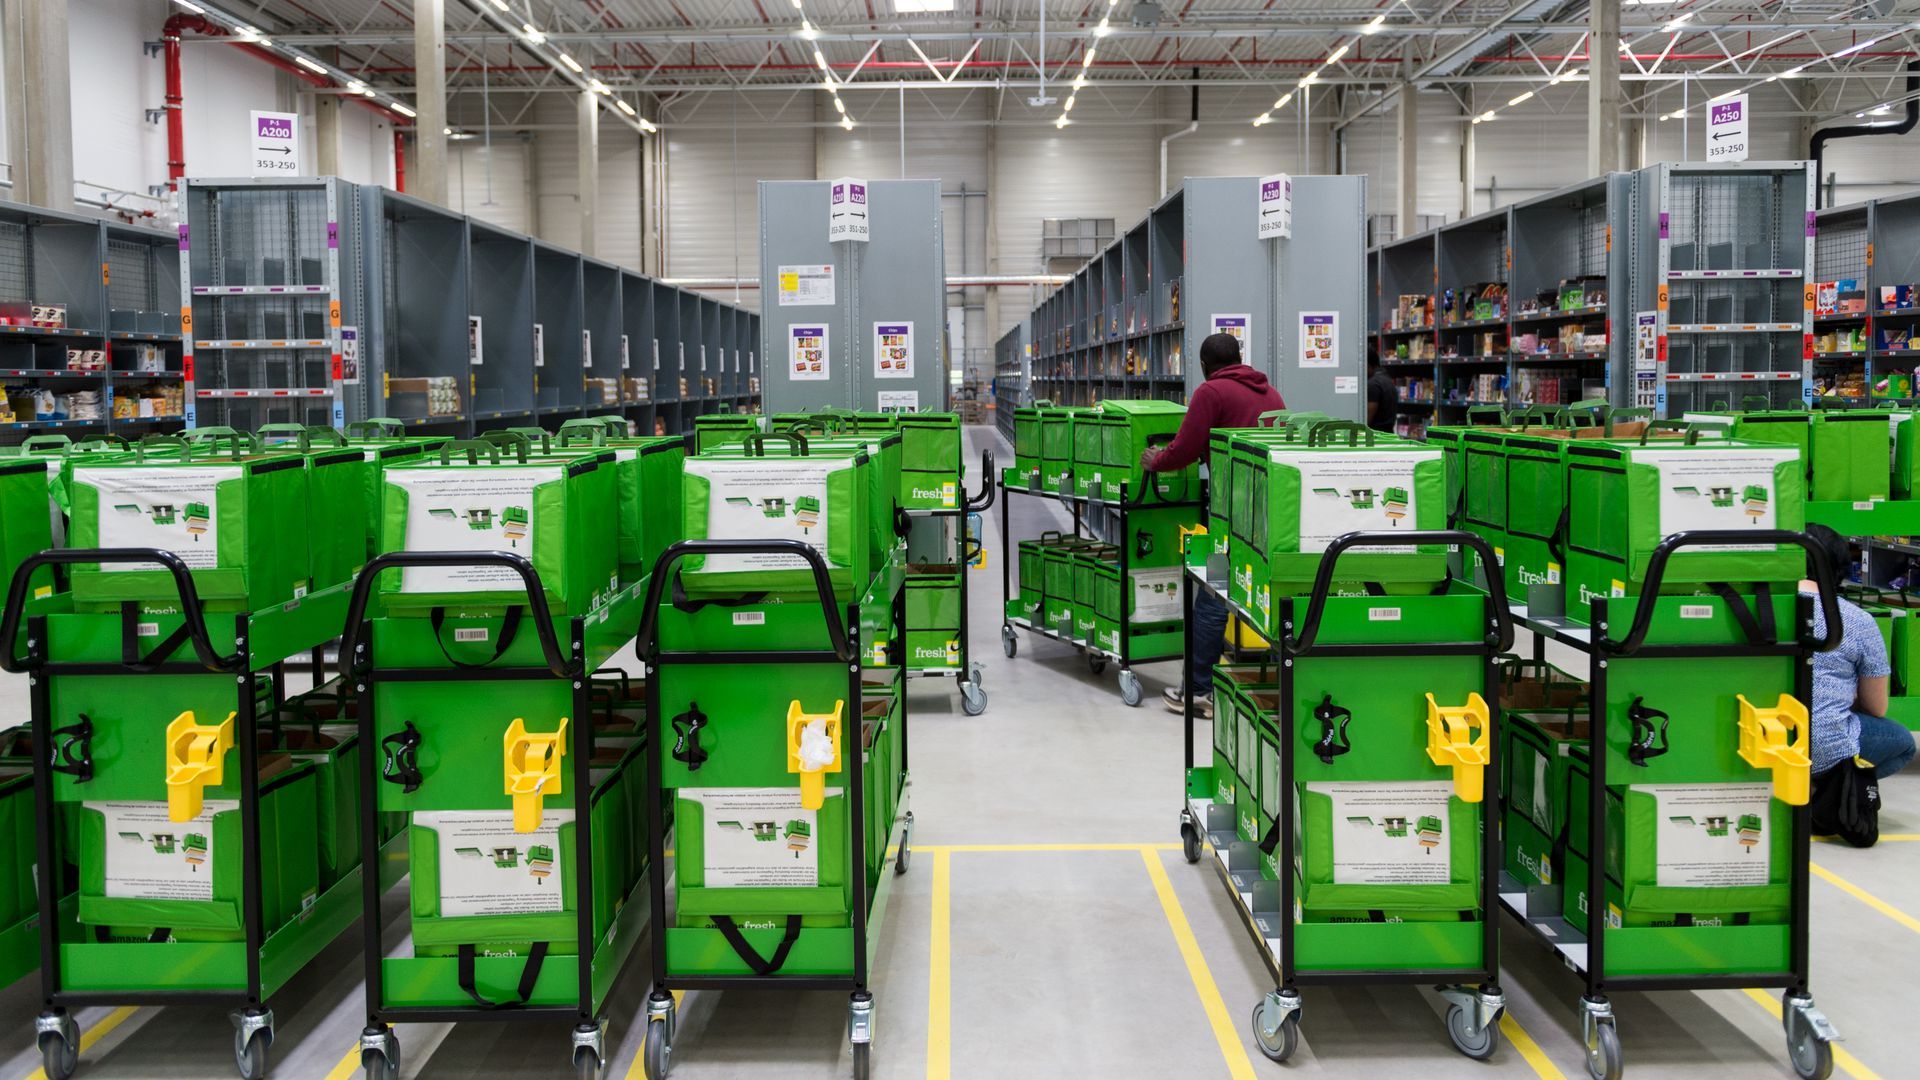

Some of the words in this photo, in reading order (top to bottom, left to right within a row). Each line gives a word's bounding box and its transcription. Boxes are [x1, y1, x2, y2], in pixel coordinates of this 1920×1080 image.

[1713, 111, 1740, 123] A250
[260, 128, 289, 138] A200
[1709, 144, 1744, 156] 353-250
[256, 159, 296, 170] 353-250
[850, 194, 865, 204] A220
[1263, 190, 1279, 201] A230
[1659, 292, 1667, 302] G
[1805, 292, 1814, 302] G
[331, 309, 339, 318] G
[183, 315, 191, 324] G
[187, 412, 194, 422] E
[335, 409, 342, 419] E
[912, 488, 944, 499] fresh
[915, 647, 947, 658] fresh
